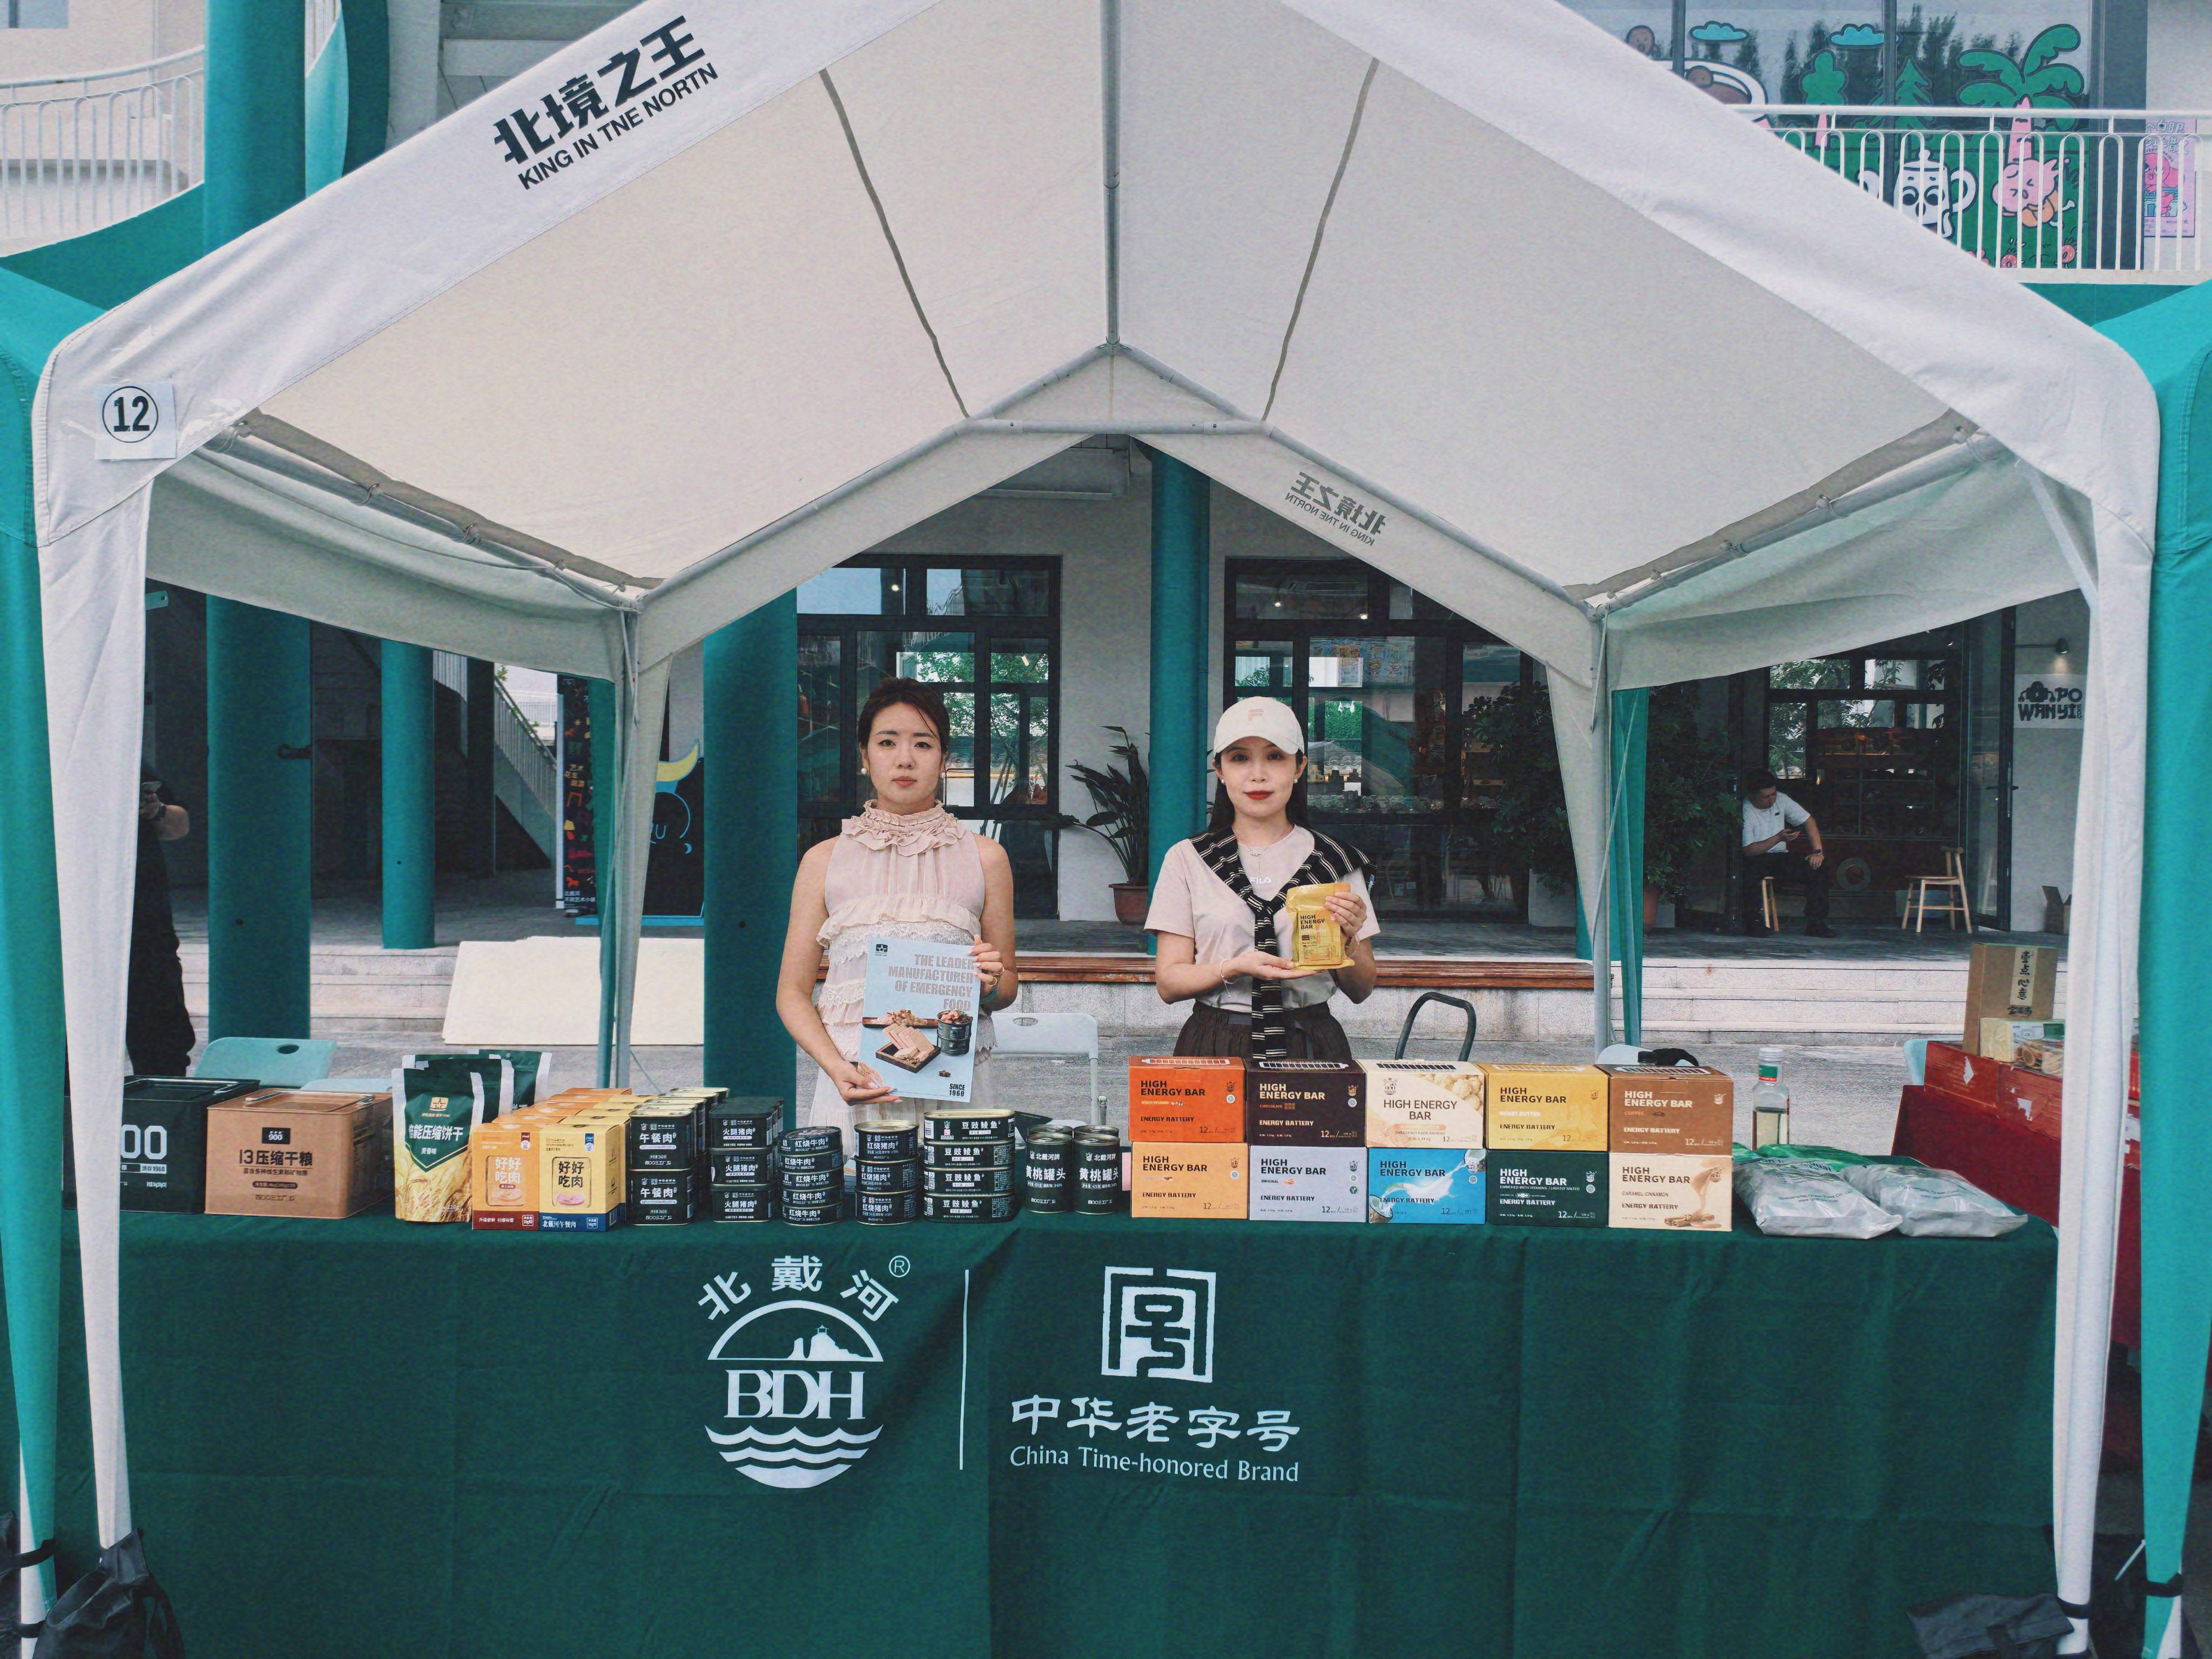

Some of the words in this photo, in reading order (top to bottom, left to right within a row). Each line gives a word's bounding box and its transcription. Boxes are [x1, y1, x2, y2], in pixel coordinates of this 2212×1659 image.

[493, 15, 705, 164] 北境之王
[518, 150, 574, 190] KING
[572, 133, 599, 158] IN
[597, 107, 644, 142] TNE
[642, 62, 719, 118] NORTN
[113, 395, 150, 432] 12
[914, 954, 933, 966] THE
[936, 955, 973, 969] LEADER
[888, 966, 973, 984] MANUFACTURER
[895, 980, 907, 992] OF
[910, 982, 973, 998] EMERGENCY
[943, 999, 972, 1011] FOOD
[1259, 1091, 1301, 1100] ENERGY
[1304, 1092, 1325, 1100] BAR
[1624, 1090, 1653, 1098] HIGH
[1384, 1100, 1411, 1108] HIGH
[1414, 1100, 1458, 1109] ENERGY
[1624, 1099, 1669, 1107] ENERGY
[1409, 1111, 1431, 1120] BAR
[962, 1121, 998, 1129] 豆豉鲮鱼
[639, 1133, 672, 1143] 午餐肉
[795, 1138, 825, 1148] 红烧牛肉
[945, 1147, 981, 1156] 豆豉鲮鱼
[495, 1157, 522, 1170] 好好
[785, 1157, 811, 1166] 红烧牛肉
[558, 1161, 584, 1174] 好好
[1261, 1166, 1303, 1175] ENERGY
[1622, 1166, 1650, 1175] HIGH
[495, 1171, 521, 1184] 吃肉
[861, 1173, 887, 1181] 红烧猪肉
[945, 1173, 981, 1182] 豆豉鲮鱼
[1026, 1165, 1066, 1181] 黄桃罐头
[1079, 1166, 1119, 1182] 黄桃罐头
[1500, 1169, 1527, 1177] HIGH
[558, 1175, 583, 1188] 吃肉
[795, 1174, 826, 1183] 红烧牛肉
[1500, 1177, 1543, 1185] ENERGY
[1545, 1178, 1567, 1186] BAR
[1622, 1175, 1666, 1183] ENERGY
[1669, 1176, 1690, 1184] BAR
[640, 1188, 673, 1198] 午餐肉
[793, 1192, 822, 1201] 红烧牛肉
[862, 1204, 889, 1212] 红烧猪肉
[943, 1199, 979, 1208] 豆豉鲮鱼
[789, 1209, 817, 1217] 红烧牛肉
[698, 1256, 899, 1321] 北戴河
[724, 1370, 866, 1420] BDH
[1011, 1394, 1300, 1451] 中华老字号
[1010, 1445, 1069, 1467] China
[1078, 1446, 1228, 1480] Time-honored
[1238, 1460, 1299, 1482] Brand
